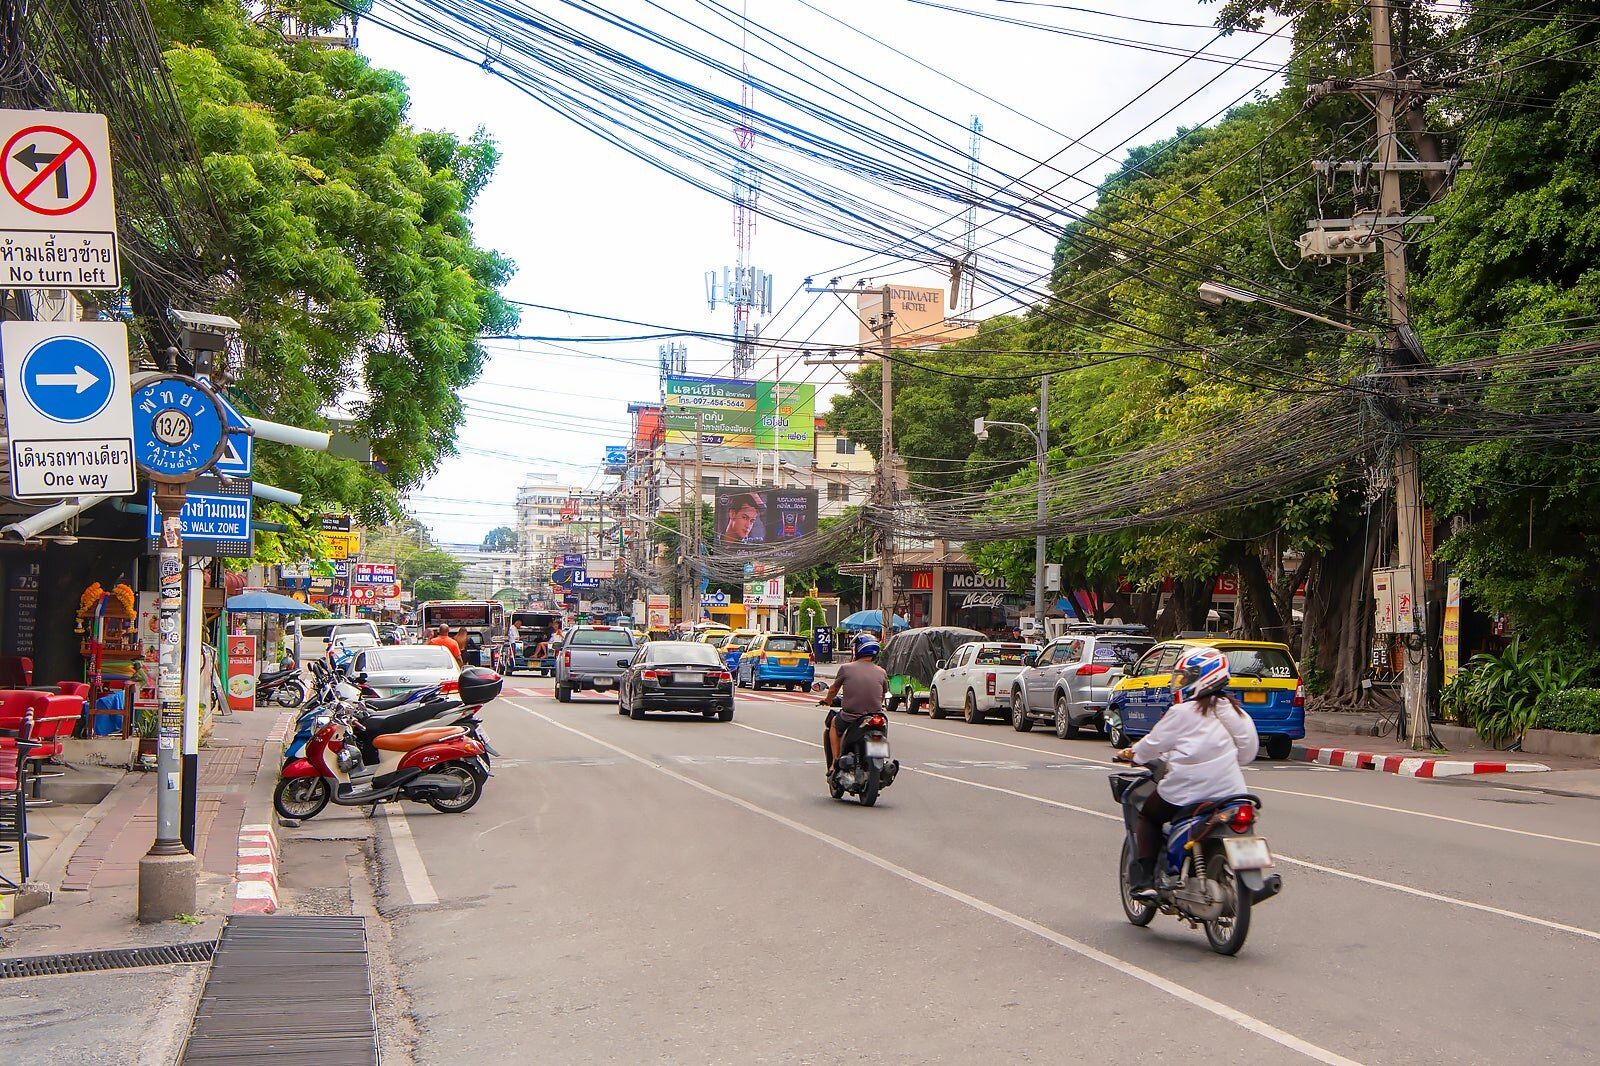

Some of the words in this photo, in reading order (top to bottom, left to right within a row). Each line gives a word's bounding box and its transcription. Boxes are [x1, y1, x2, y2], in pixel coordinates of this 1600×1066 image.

[1, 234, 111, 263] ห้ามเลี้ยวซ้าย
[9, 267, 33, 281] No
[39, 267, 72, 282] turn
[79, 267, 105, 282] left
[890, 289, 939, 303] INTIMATE
[902, 302, 927, 312] HOTEL
[139, 388, 206, 417] พัทยา
[159, 418, 187, 437] 13/2
[18, 444, 128, 468] เดินรถทางเดียว
[146, 441, 201, 459] PATTAYA
[44, 472, 74, 486] One
[79, 474, 108, 489] way
[191, 521, 215, 533] WALK
[217, 523, 240, 534] ZONE
[1270, 666, 1290, 675] 1122
